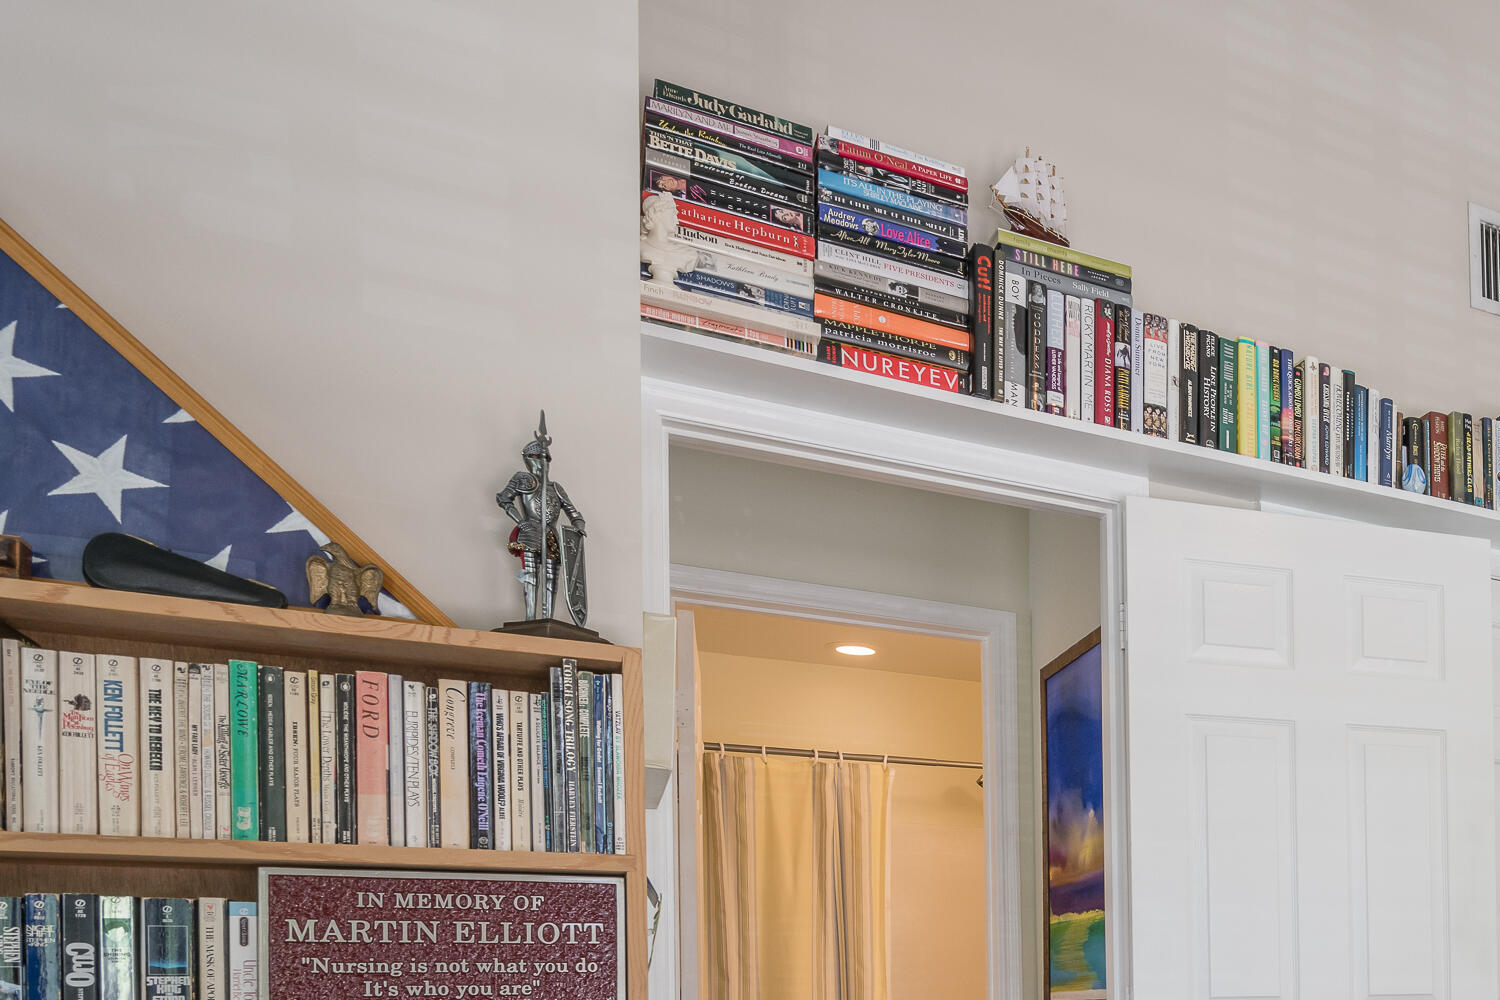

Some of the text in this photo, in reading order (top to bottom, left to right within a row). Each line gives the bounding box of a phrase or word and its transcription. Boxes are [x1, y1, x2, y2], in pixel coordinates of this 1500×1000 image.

[688, 93, 793, 136] Judy Garland
[649, 134, 737, 170] BETTE DAVIS
[677, 204, 791, 245] atharine Hepburn
[823, 213, 859, 231] Meadows
[828, 207, 856, 223] Audrey
[677, 225, 719, 245] Hudson
[977, 255, 992, 291] Cut!
[1015, 248, 1047, 267] STILL
[1052, 259, 1080, 278] HERE
[1012, 278, 1020, 300] BOY
[1021, 266, 1110, 298] In Pieces Sally Field
[835, 288, 878, 305] WALTER
[883, 300, 938, 320] CRONKITE
[824, 318, 937, 350] MAPPLETHORPE
[1083, 304, 1094, 339] RICKY
[824, 327, 937, 359] patricia morrisroe
[1133, 316, 1143, 377] Donna Summer
[841, 346, 958, 390] NUREYEV
[1083, 341, 1094, 387] MARTIN
[1009, 382, 1019, 408] MAN
[1104, 358, 1112, 414] DIANA ROSS
[1203, 376, 1211, 419] HISTORY
[1210, 420, 1217, 433] IN
[1384, 429, 1392, 461] Marilyn
[563, 663, 576, 698] TORCH
[103, 679, 124, 752] KEN FOLLETT
[362, 680, 380, 739] FORD
[444, 687, 466, 740] Congreve
[564, 700, 576, 727] SONG
[149, 689, 162, 771] THE KEY TO REBECCA
[475, 692, 489, 831] The Iceman Cometh Eugene O'Neill
[566, 729, 577, 773] TRILOGY
[97, 763, 122, 792] Eagles
[112, 752, 134, 802] On Wings
[356, 891, 545, 911] IN MEMORY OF
[5, 925, 20, 964] STEPHEN
[284, 918, 603, 945] MARTIN ELLIOTT
[65, 942, 95, 987] CUJO
[146, 975, 190, 986] STEPHEN
[242, 959, 257, 989] Uncle
[301, 956, 598, 977] "Nursing is not what you do
[156, 985, 182, 995] KING
[363, 979, 542, 1000] It's who you are"
